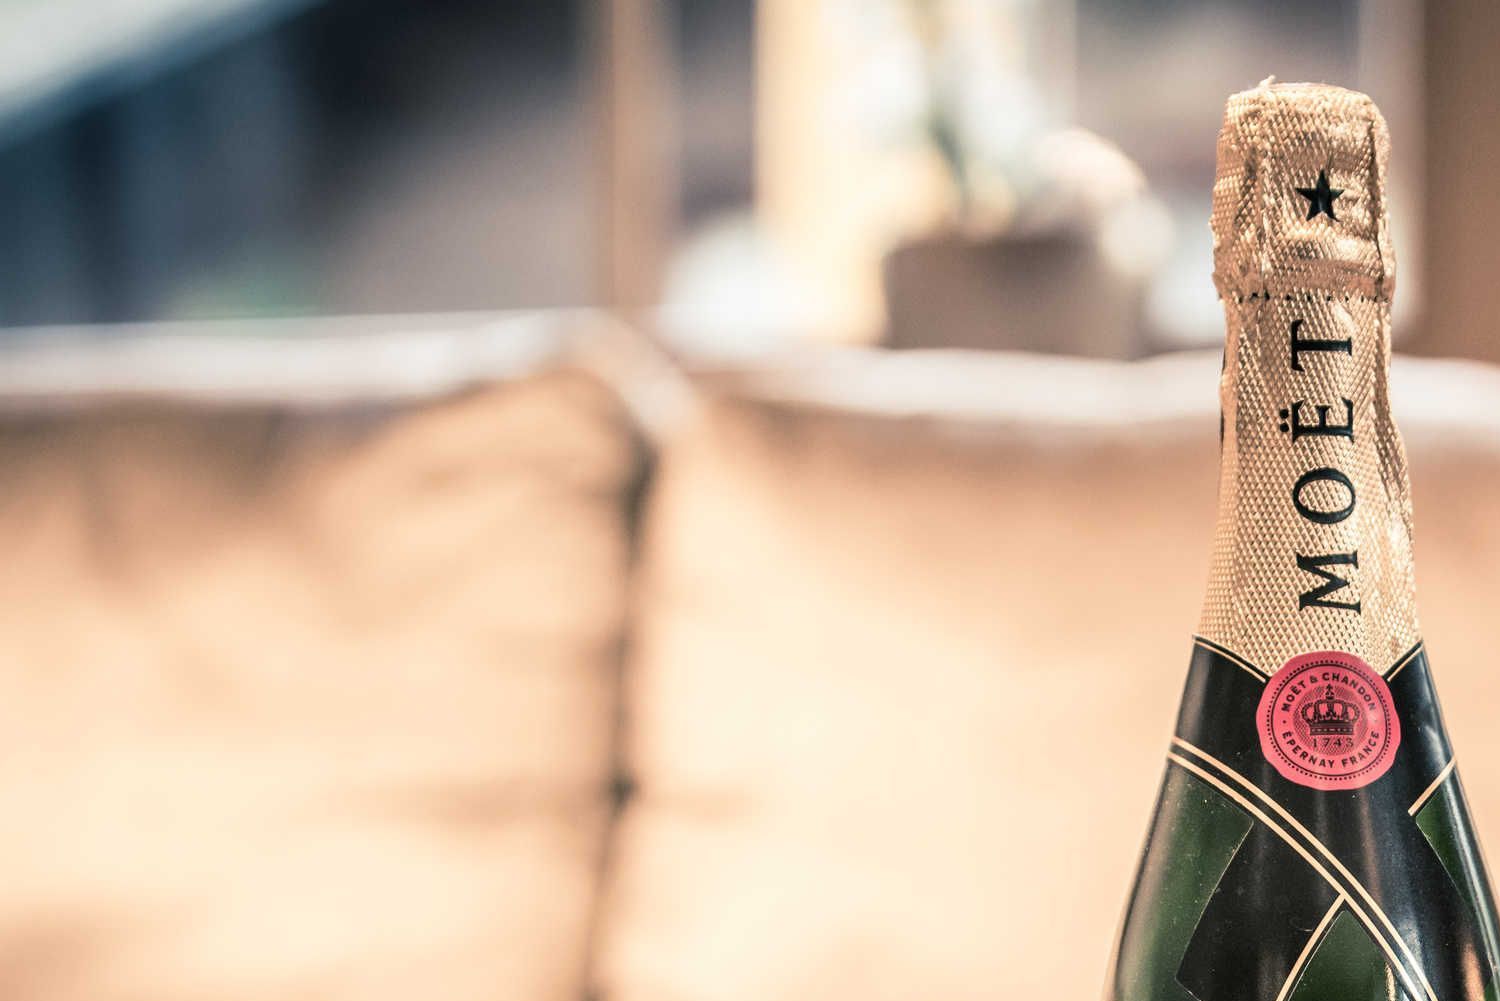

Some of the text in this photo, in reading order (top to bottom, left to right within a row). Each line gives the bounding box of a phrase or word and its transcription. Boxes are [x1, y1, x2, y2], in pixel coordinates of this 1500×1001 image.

[1279, 318, 1362, 616] MOËT
[1281, 672, 1377, 713] MOËT & CHANDON
[1312, 737, 1355, 749] 1743
[1341, 730, 1380, 768] FRANCE
